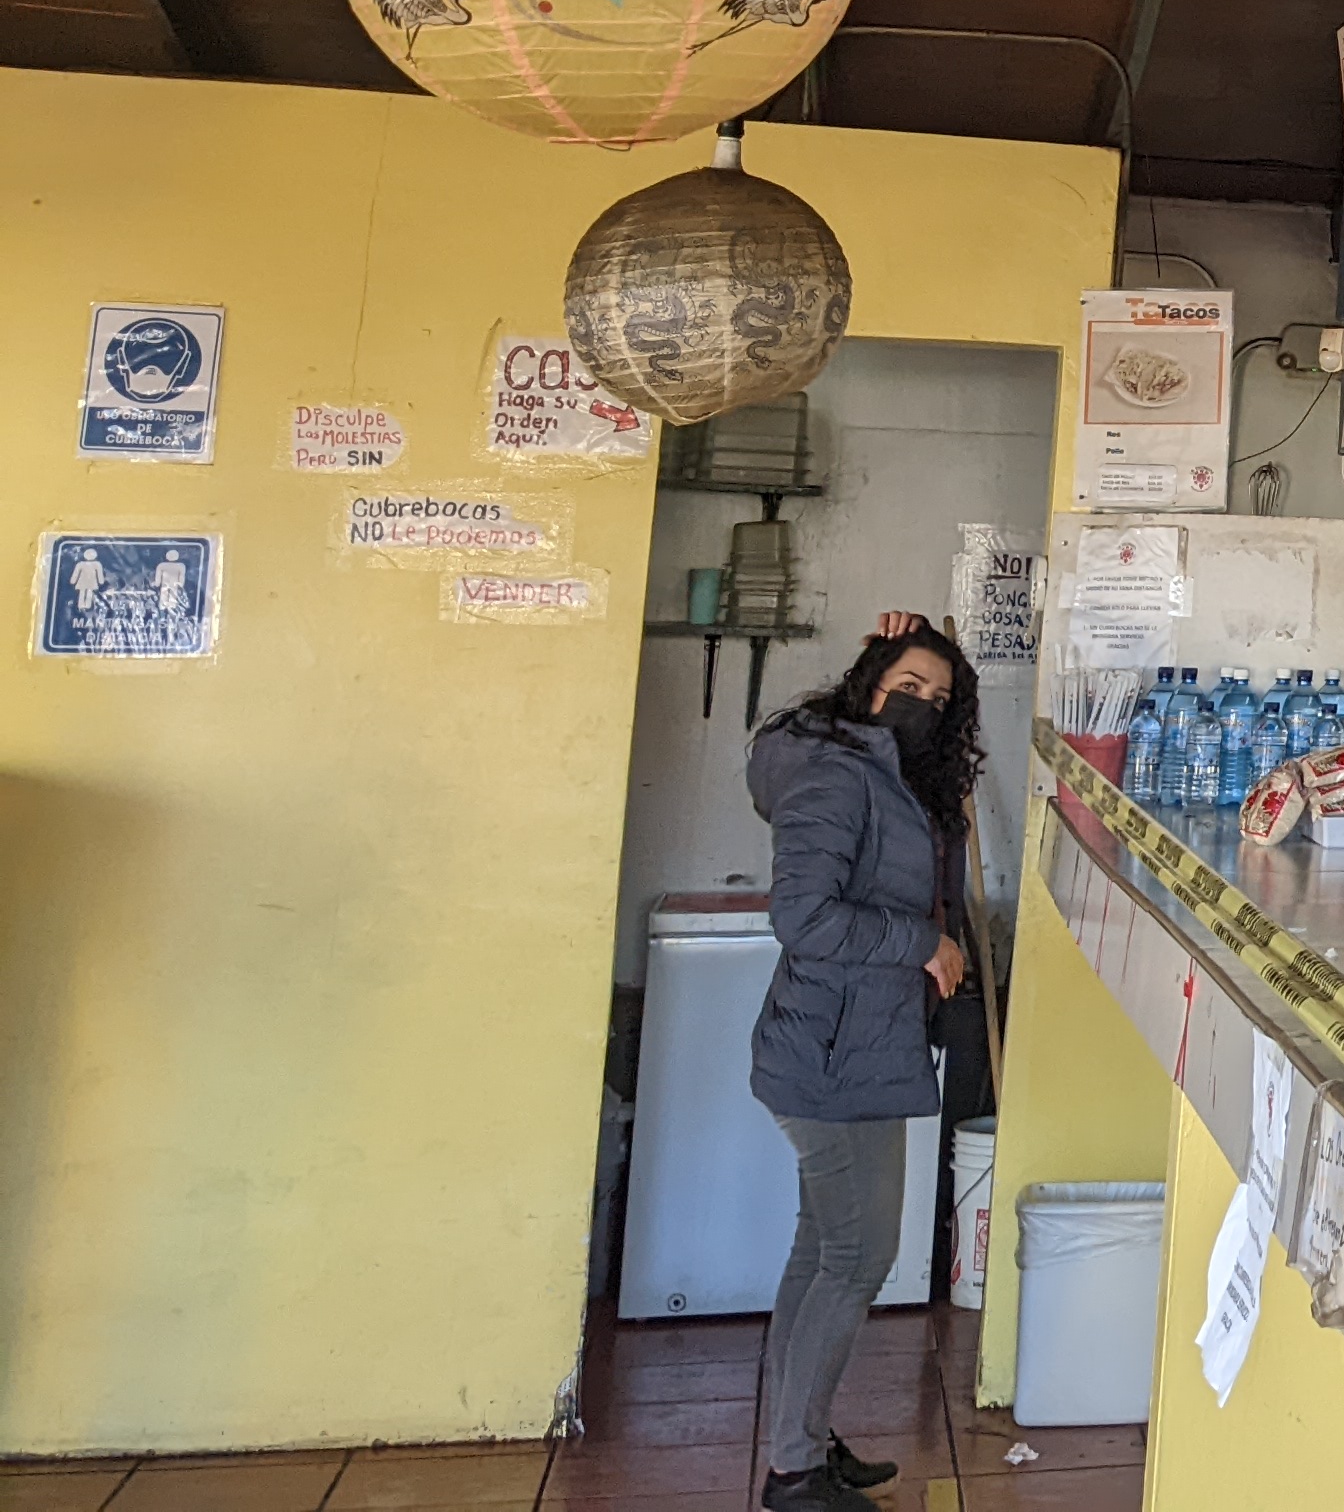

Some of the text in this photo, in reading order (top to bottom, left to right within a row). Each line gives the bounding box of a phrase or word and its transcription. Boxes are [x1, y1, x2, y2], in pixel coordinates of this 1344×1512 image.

[1157, 304, 1221, 320] Tacos
[504, 345, 598, 391] Ca
[498, 392, 545, 410] Haga
[96, 411, 195, 423] USO OBLIGATORIO
[295, 407, 387, 433] Disculpe
[494, 413, 558, 431] Orden
[137, 423, 153, 434] DE
[321, 429, 402, 446] MOLESTIAS
[347, 450, 384, 466] SIN
[352, 496, 501, 521] Cubrebocas
[350, 521, 385, 545] NO
[993, 554, 1033, 581] NO!
[461, 577, 573, 605] VENDER
[985, 583, 1031, 607] PONG
